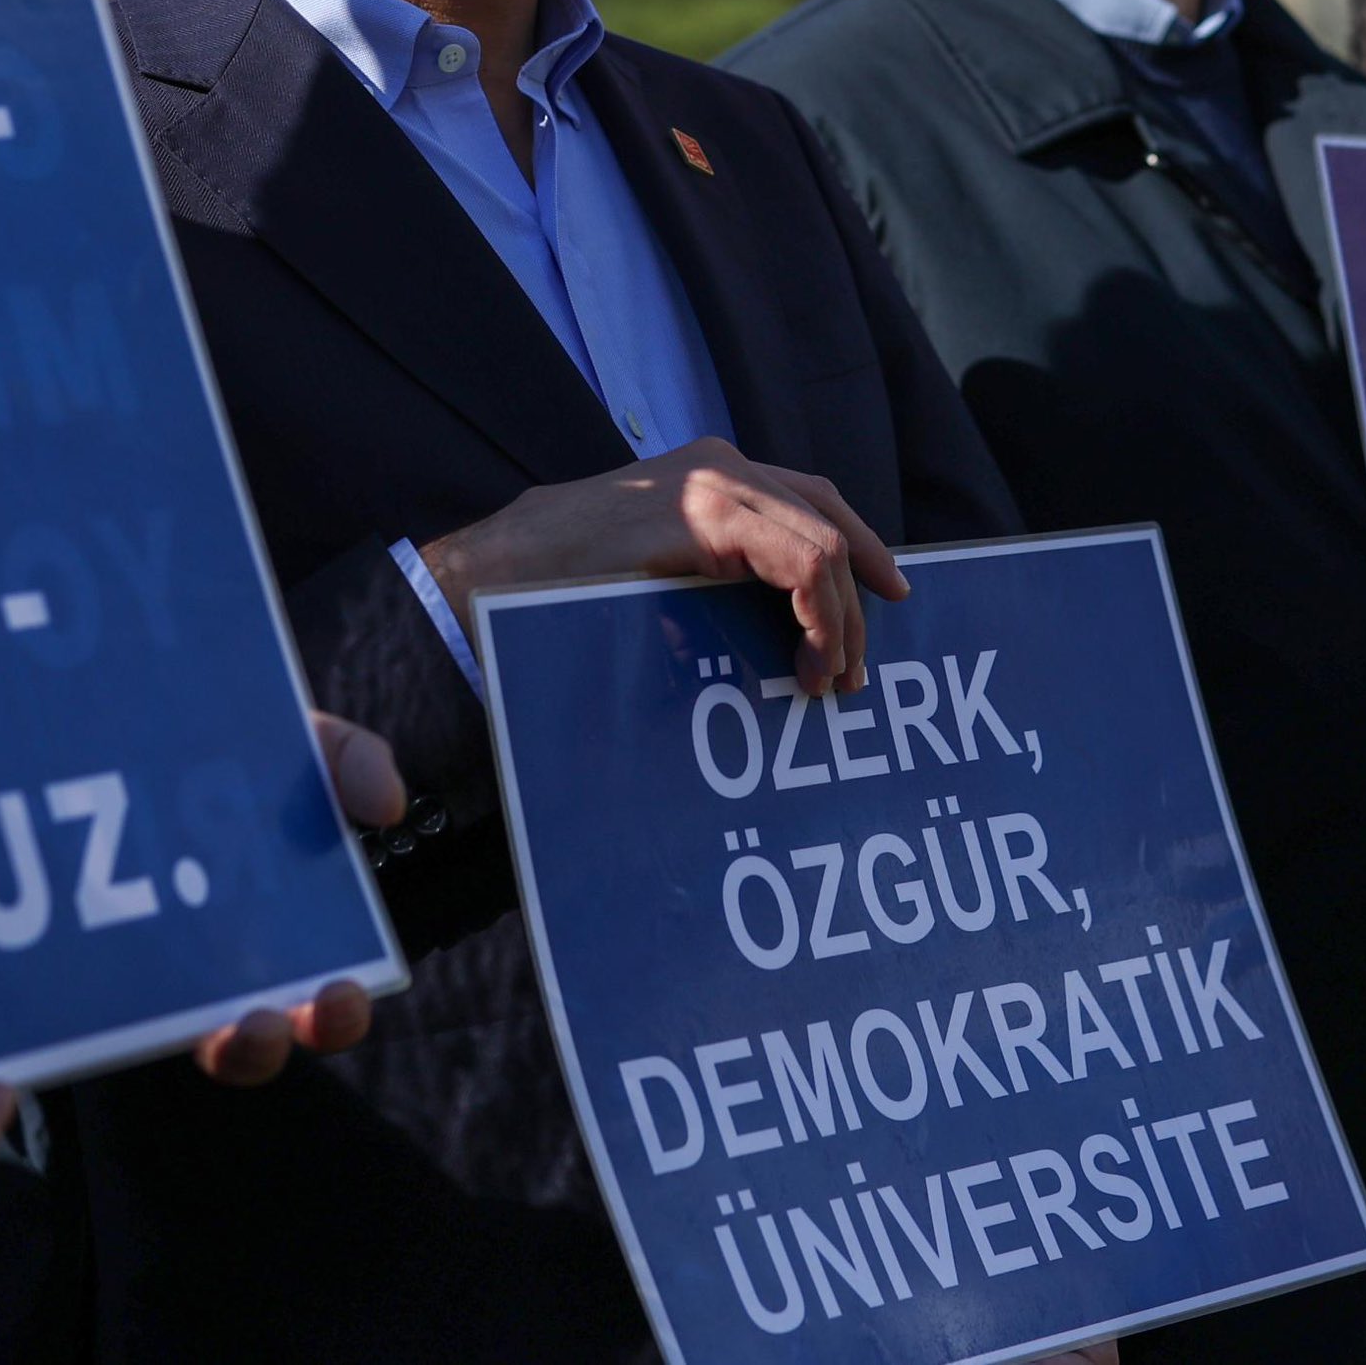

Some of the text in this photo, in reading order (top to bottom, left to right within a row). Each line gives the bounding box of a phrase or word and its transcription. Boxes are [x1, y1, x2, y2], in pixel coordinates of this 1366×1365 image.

[692, 649, 1043, 800] ÖZERK,
[722, 795, 1092, 970] ÖZGÜR,
[618, 924, 1265, 1176] DEMOKRATİK
[713, 1097, 1290, 1334] ÜNİVERSİTE
